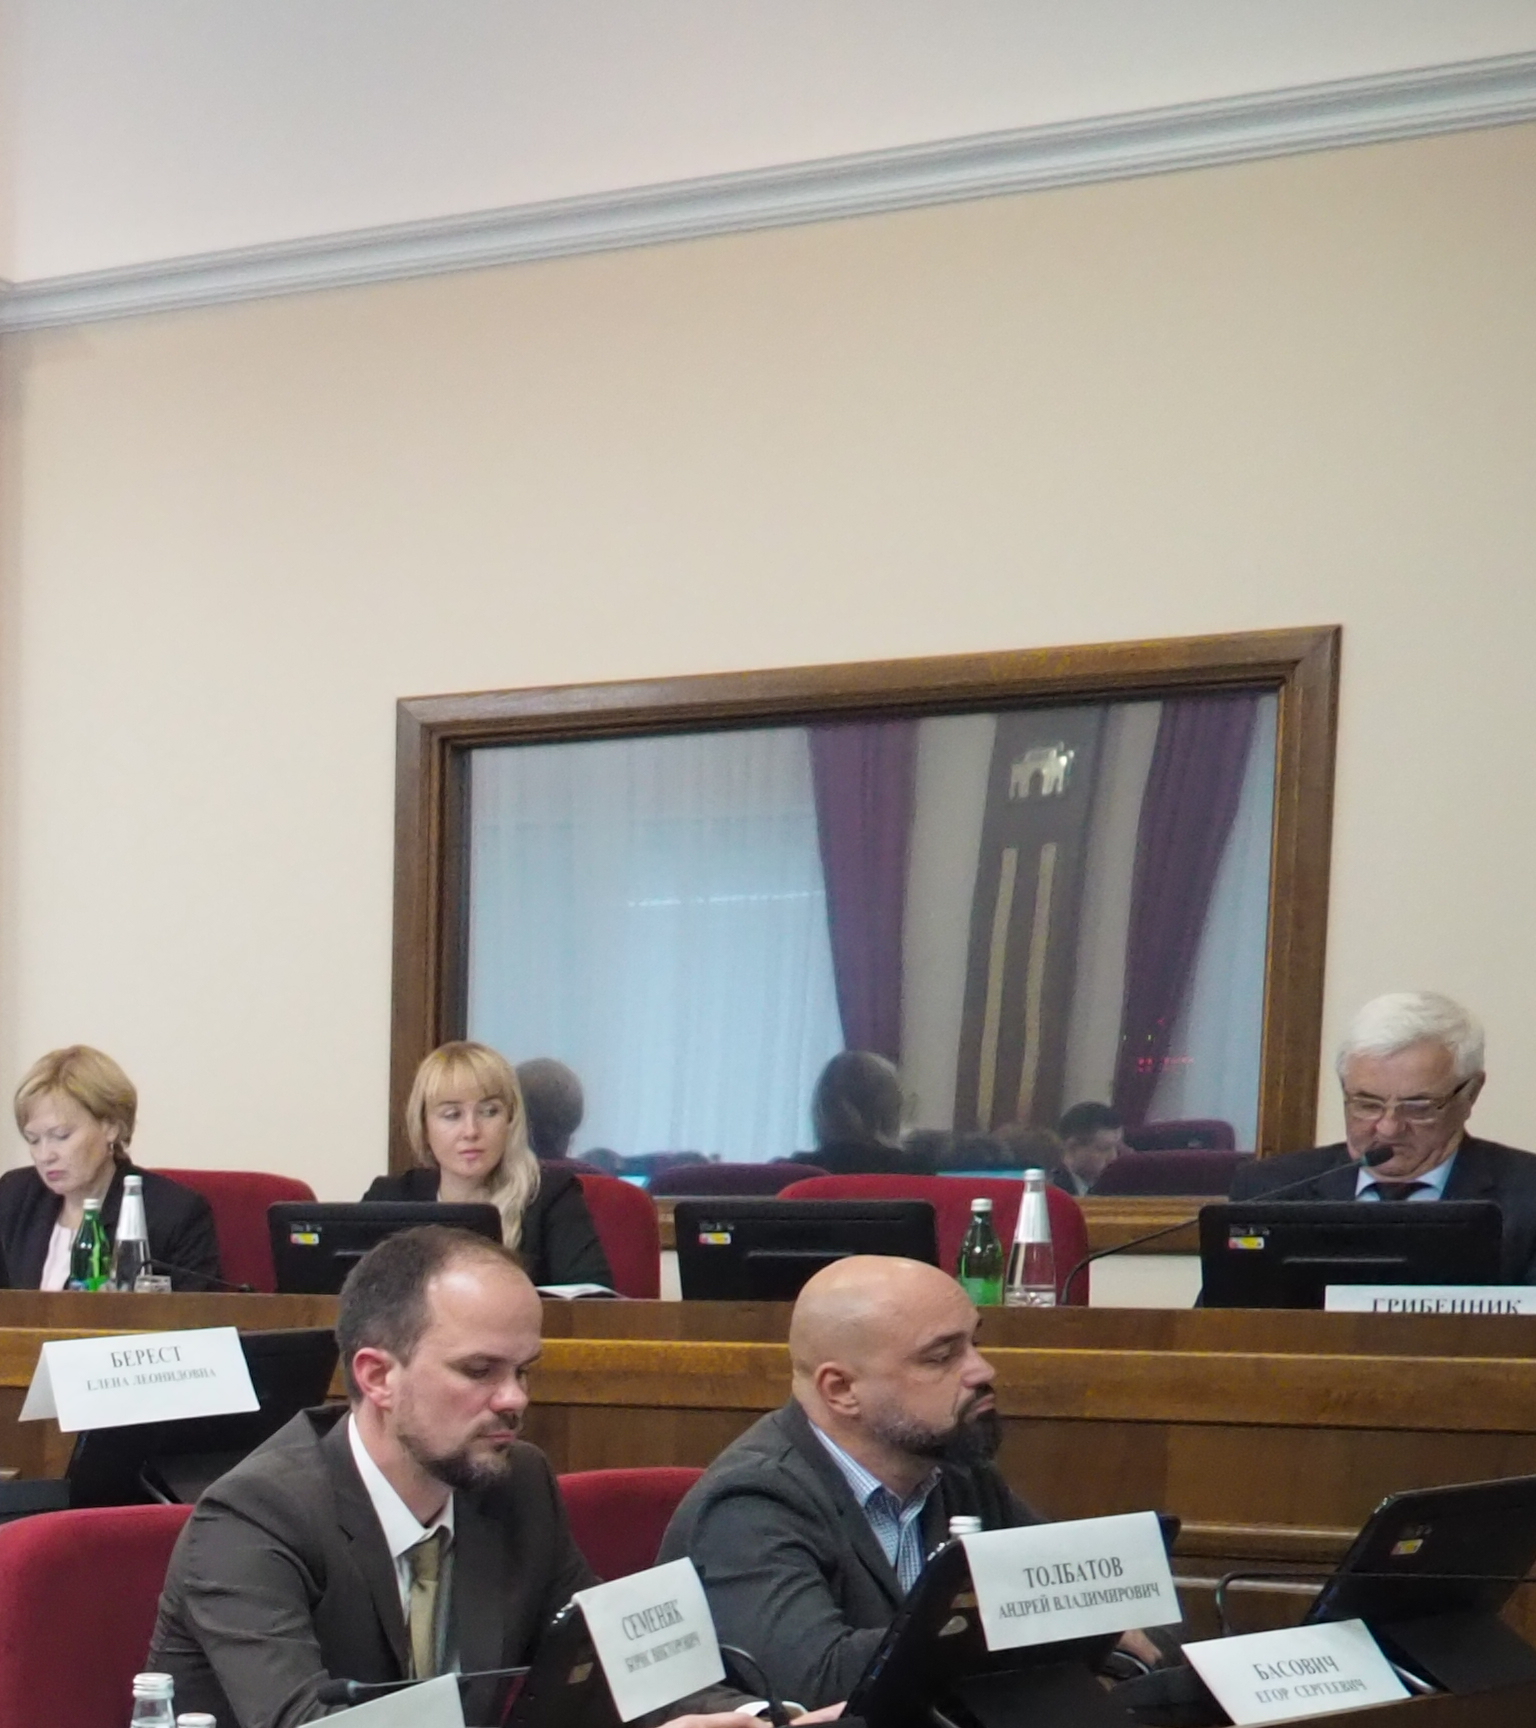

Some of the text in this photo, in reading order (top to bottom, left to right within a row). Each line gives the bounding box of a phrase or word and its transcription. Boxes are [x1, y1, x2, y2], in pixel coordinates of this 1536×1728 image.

[110, 1345, 182, 1369] БЕРЕСТ
[86, 1367, 218, 1392] ЕЛЕНА ЛЕОНИДОВНА
[1022, 1556, 1124, 1589] ТОЛБАТОВ
[998, 1581, 1161, 1619] АНДРЕЙ ВЛАДИМИРОВИЧ
[1252, 1655, 1340, 1681] БАСОВИЧ
[1255, 1678, 1368, 1703] ЕГОР СЕРГЕЕВИЧ
